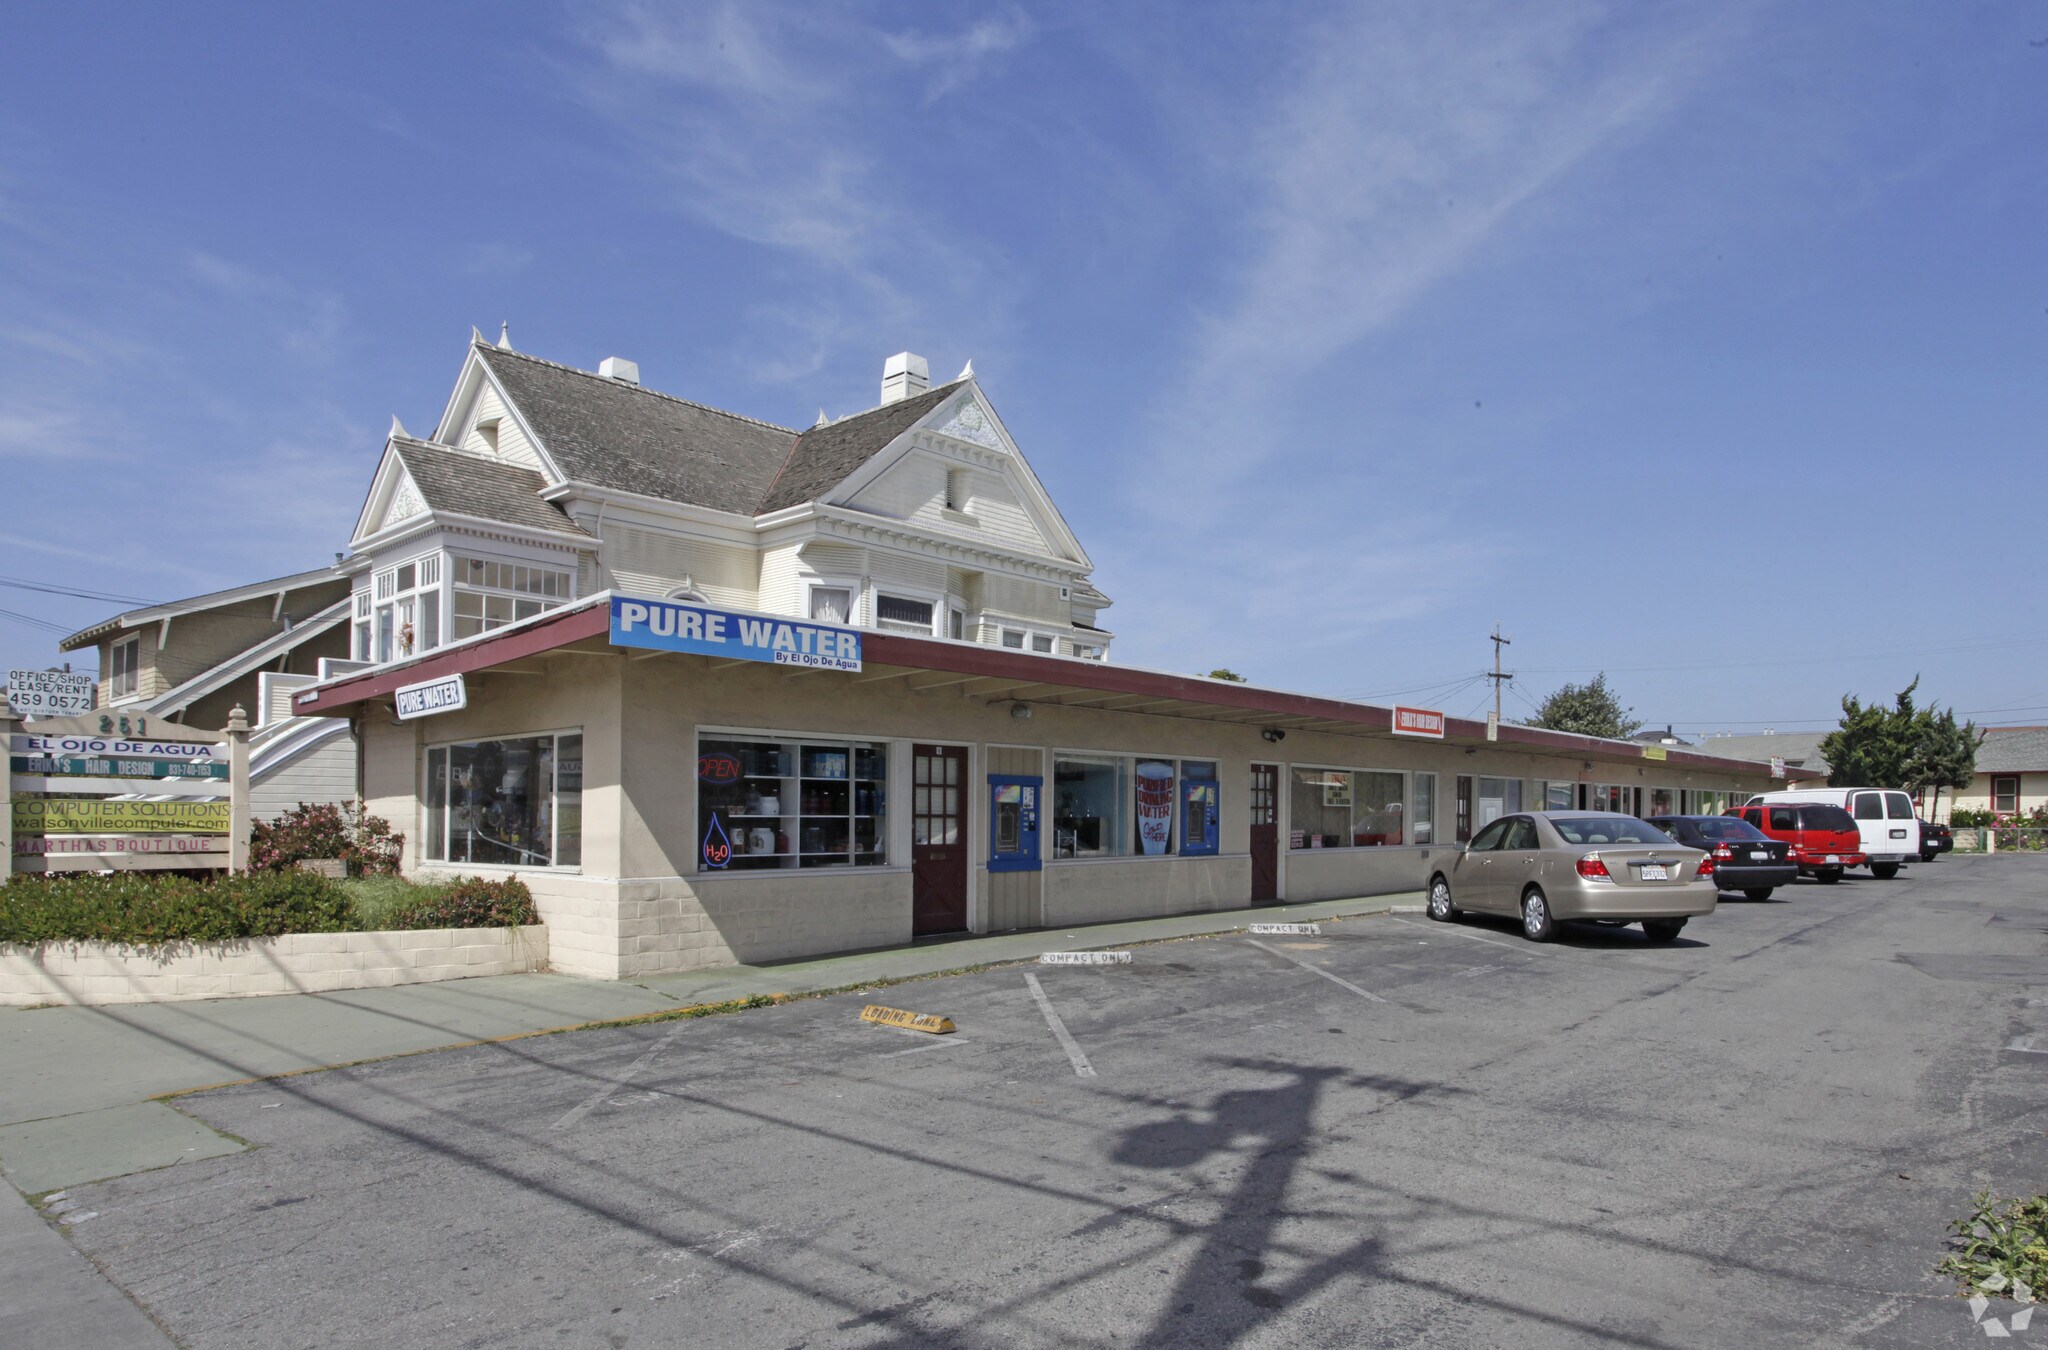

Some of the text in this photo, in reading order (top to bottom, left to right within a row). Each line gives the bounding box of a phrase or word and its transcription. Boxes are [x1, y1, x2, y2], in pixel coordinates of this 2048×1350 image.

[620, 602, 857, 659] PURE WATER
[776, 651, 857, 669] By El Ojo De Agua
[10, 670, 91, 685] OFFICE/SHOP
[10, 681, 88, 694] LEASE/RENT
[10, 693, 90, 710] 459 0572
[399, 682, 459, 714] PURE WATER
[99, 714, 147, 736] 251
[28, 738, 212, 756] EL OJO DE AGUA
[28, 758, 71, 773] ERIKA'S
[85, 759, 110, 774] HAIR
[118, 760, 155, 776] DESIGN
[698, 759, 740, 778] OPEN
[1137, 775, 1173, 792] PURIFIED
[14, 801, 230, 817] COMPUTER SOLUTIONS
[1138, 803, 1170, 819] WATER
[14, 816, 229, 830] watsonvillecomputer.com
[1152, 832, 1166, 842] HERE
[15, 839, 210, 853] MARTHAS BOUTIQUE
[1250, 925, 1292, 933] COMPACT
[1041, 953, 1130, 963] COMPACT ONLY
[865, 1006, 907, 1022] LOADING
